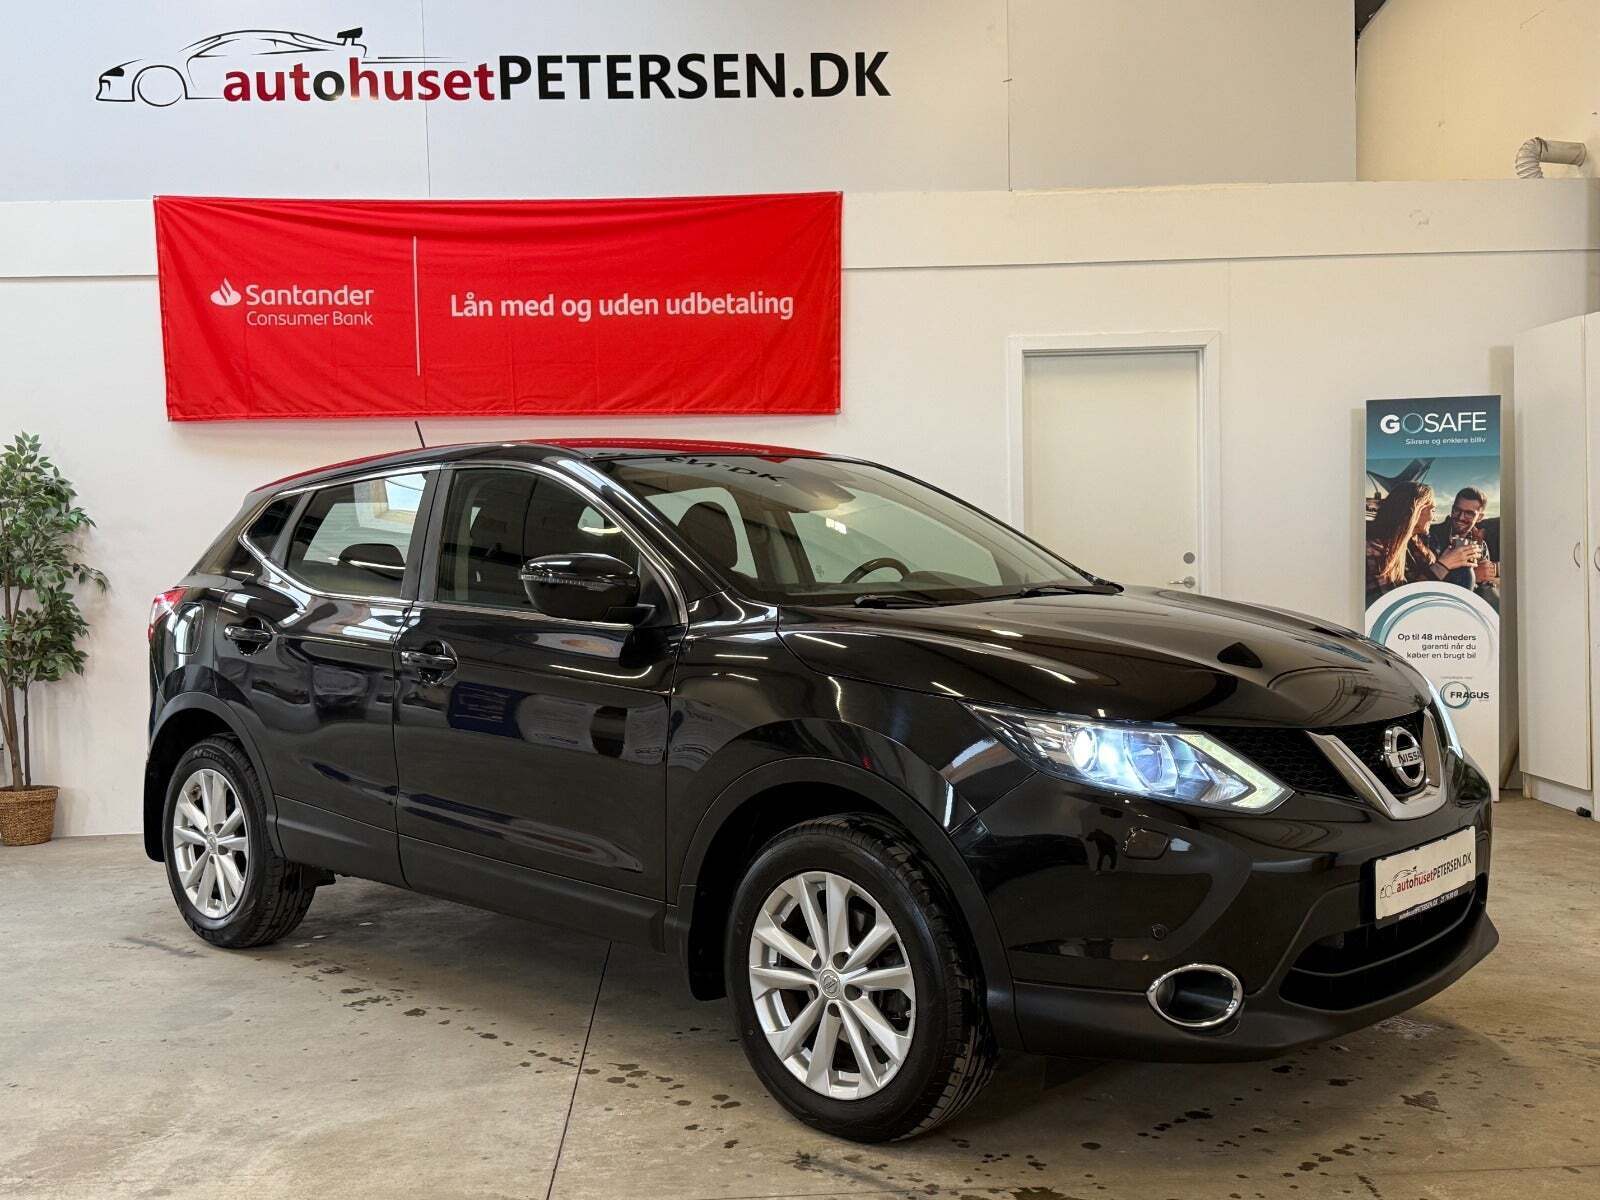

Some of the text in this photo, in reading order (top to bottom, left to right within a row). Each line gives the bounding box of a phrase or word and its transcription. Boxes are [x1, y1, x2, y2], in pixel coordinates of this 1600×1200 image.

[222, 51, 891, 103] autohusetPETERSEN.DK
[245, 284, 375, 306] Santander
[450, 290, 794, 323] Lån med og uden udbetaling
[246, 311, 374, 326] Consumer Bank
[1380, 411, 1488, 434] GOSAFE
[1397, 633, 1477, 642] Op til 48 måneders
[1421, 643, 1449, 651] garanti
[1406, 651, 1430, 659] køber
[1443, 652, 1465, 660] brugt
[1450, 691, 1490, 699] FRAGUS
[1398, 750, 1421, 764] NISS
[1396, 852, 1473, 893] autohusetPETERSEN.DK
